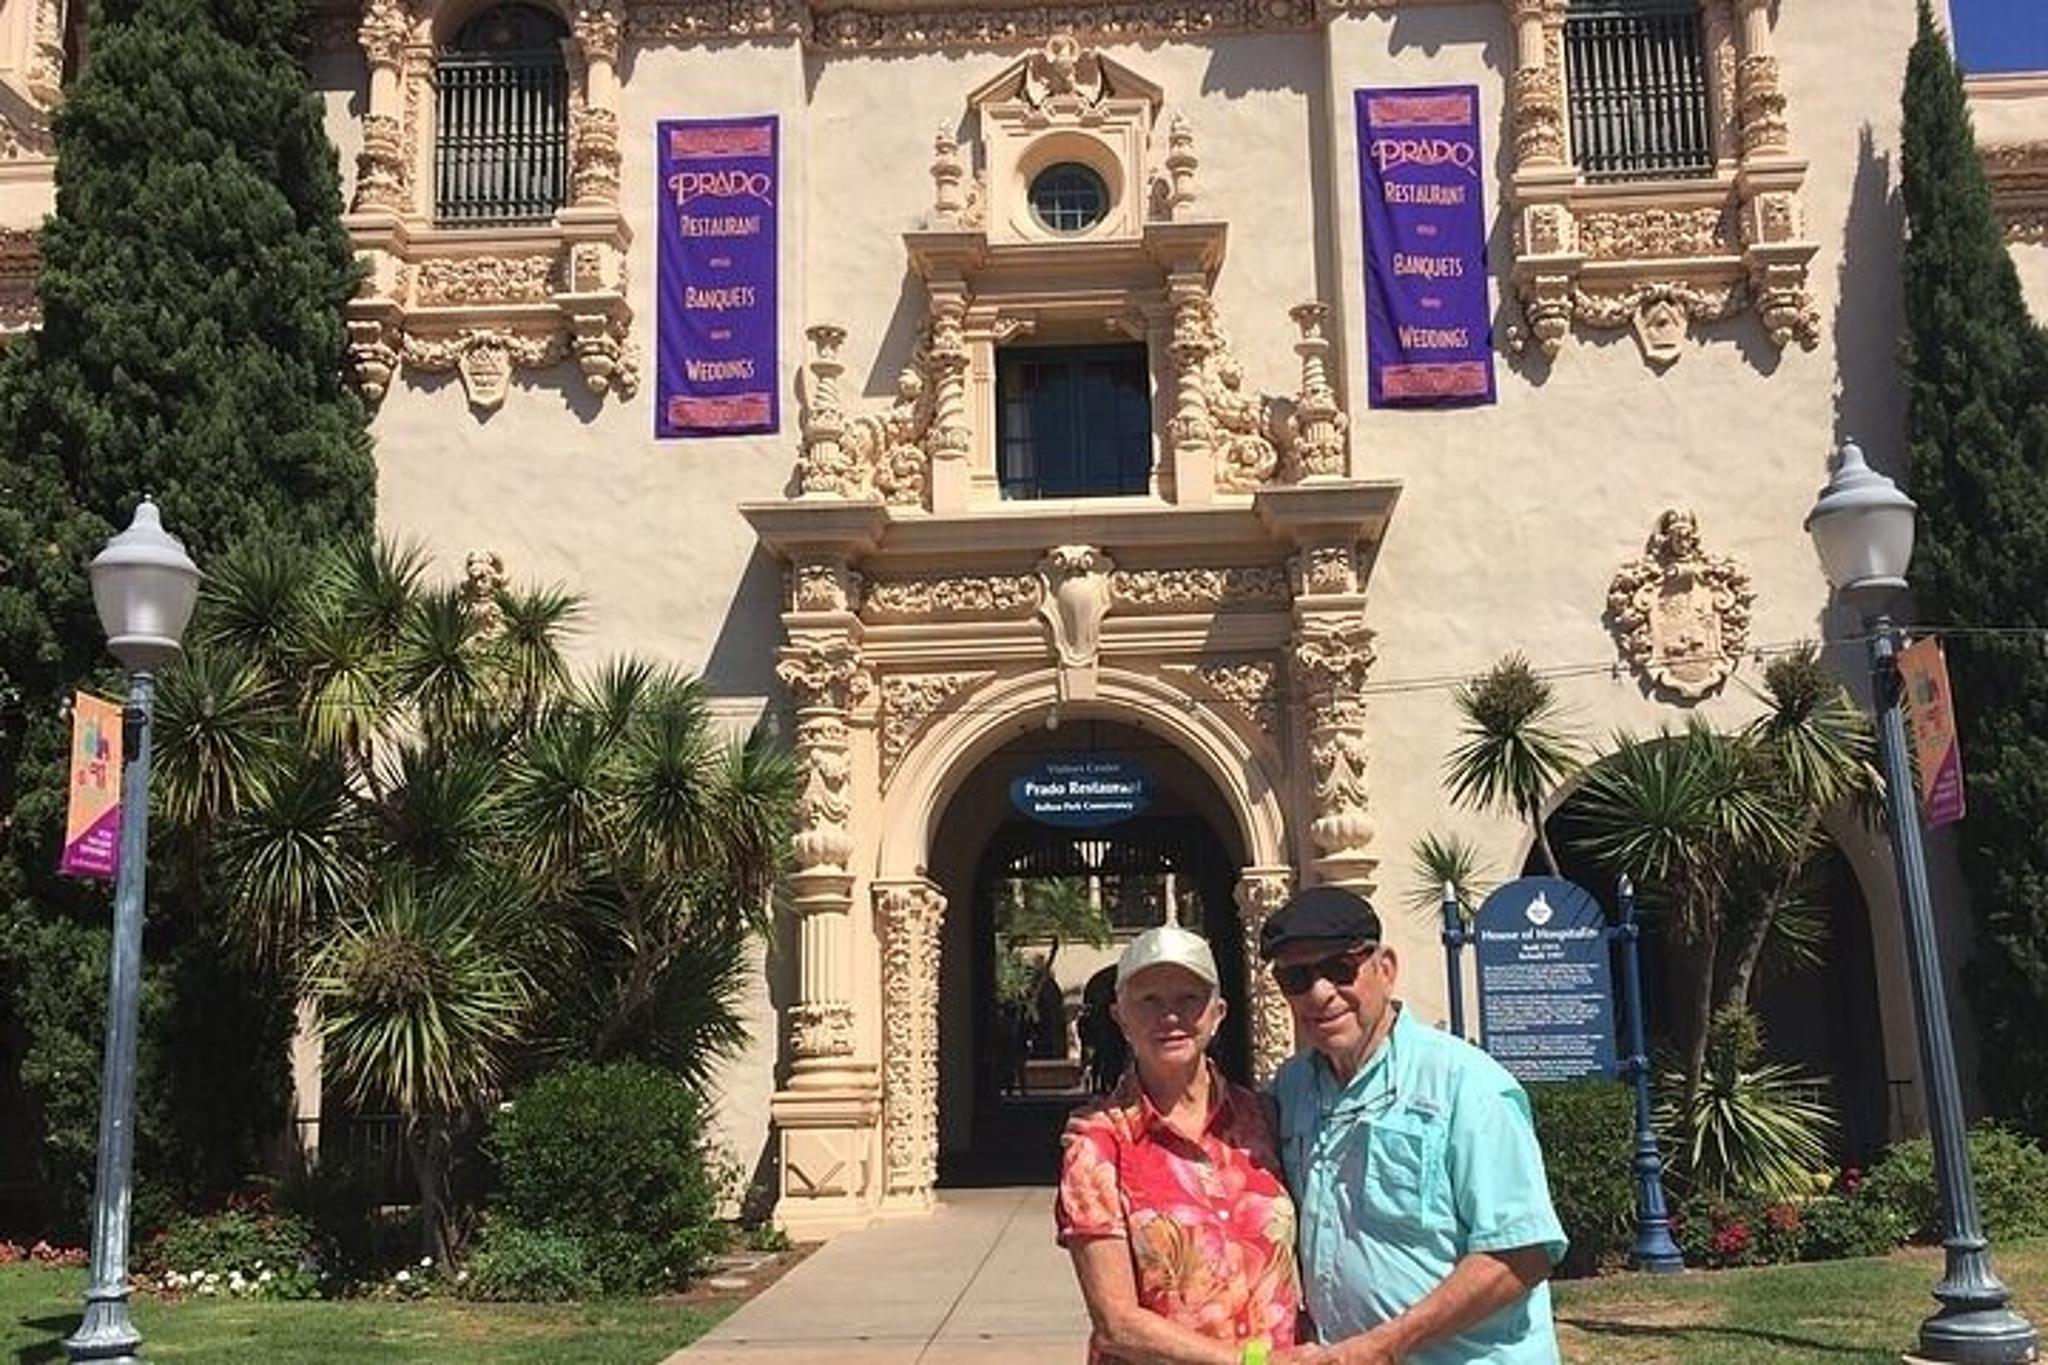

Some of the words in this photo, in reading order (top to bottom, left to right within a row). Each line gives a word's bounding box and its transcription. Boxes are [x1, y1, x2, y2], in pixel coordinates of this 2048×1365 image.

[1370, 138, 1478, 176] PRADO
[668, 170, 773, 206] PRADO
[1384, 181, 1466, 204] RESTAURANT
[680, 215, 761, 238] RESTAURANT
[1393, 252, 1463, 281] BANQUETS
[685, 286, 755, 312] BANQUETS
[1398, 325, 1469, 349] WEDDINGS
[685, 358, 755, 382] WEDDINGS
[1025, 781, 1066, 797] Prado
[1063, 801, 1081, 811] Park
[1481, 929, 1519, 941] House
[1521, 928, 1534, 940] of
